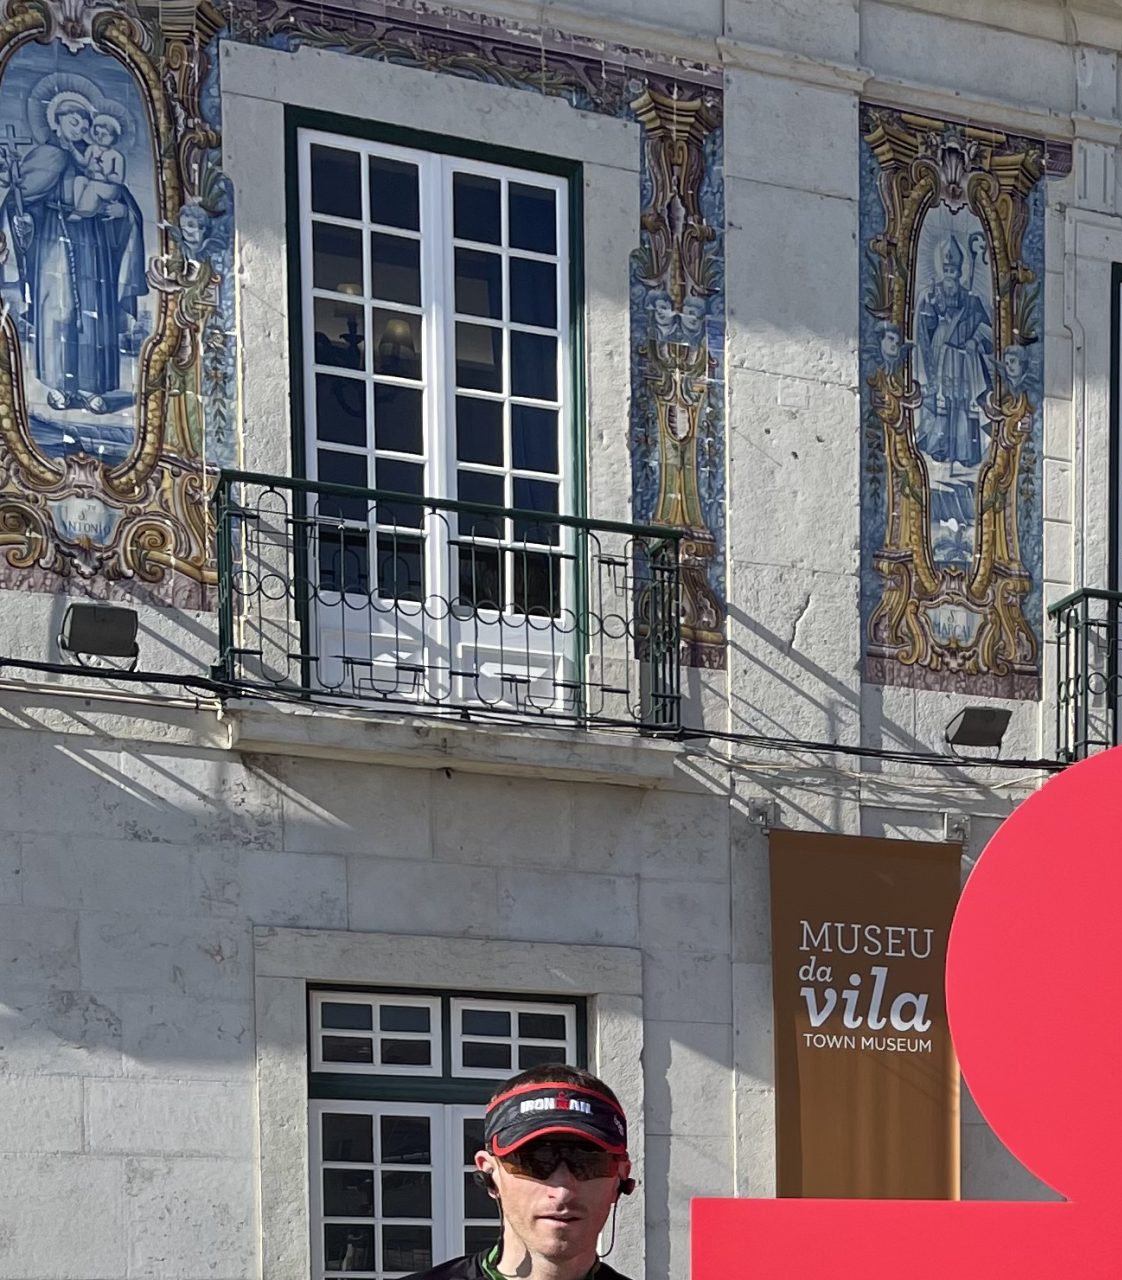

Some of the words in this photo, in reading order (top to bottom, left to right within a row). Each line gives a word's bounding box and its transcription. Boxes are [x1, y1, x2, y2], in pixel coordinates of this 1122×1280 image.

[798, 920, 934, 959] MUSEU
[798, 956, 833, 983] da
[800, 966, 932, 1033] vila
[803, 1033, 856, 1050] TOWN
[861, 1037, 932, 1053] MUSEUM
